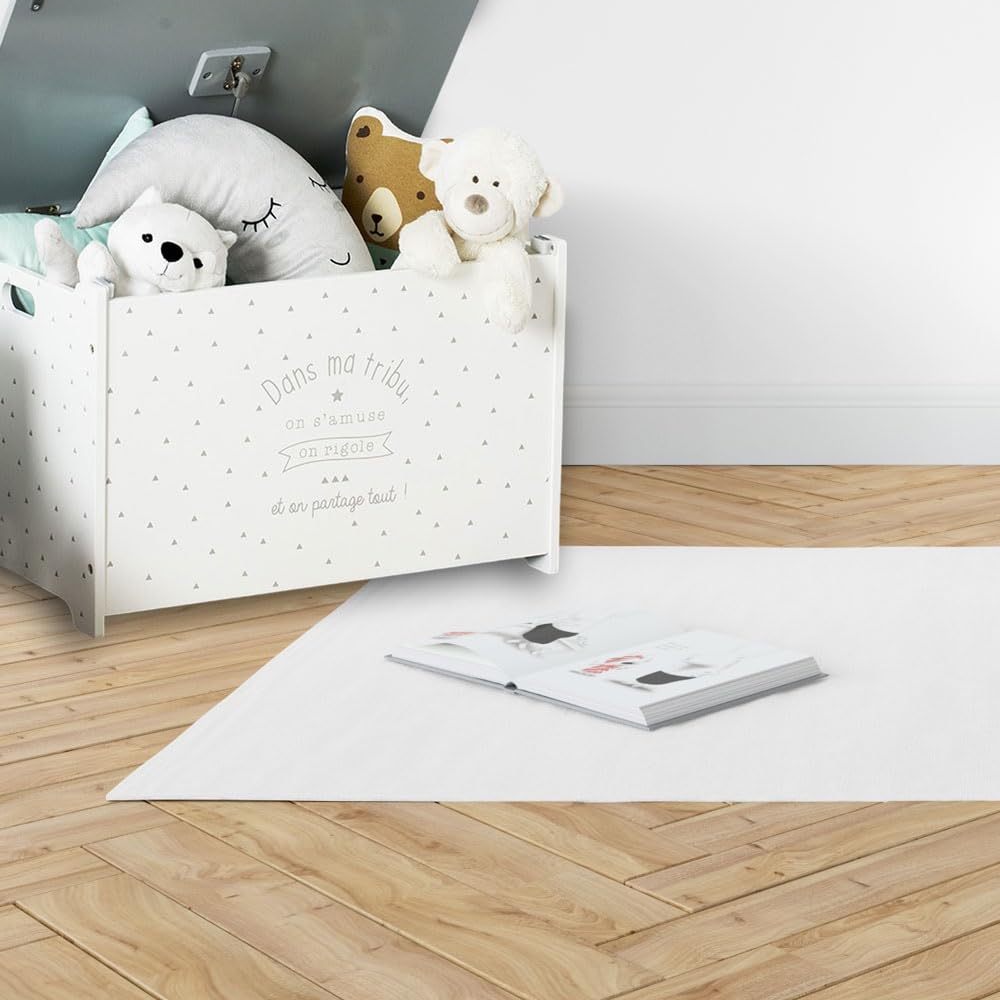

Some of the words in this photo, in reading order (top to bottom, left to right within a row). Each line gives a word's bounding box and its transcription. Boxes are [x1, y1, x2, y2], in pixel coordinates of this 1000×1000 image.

[260, 363, 318, 406] Dans
[327, 353, 356, 377] ma
[285, 418, 305, 431] on
[313, 409, 386, 428] s'amuse
[298, 446, 318, 459] on
[324, 440, 375, 458] rigole
[271, 497, 285, 516] et
[288, 503, 309, 514] on
[312, 491, 365, 519] partage
